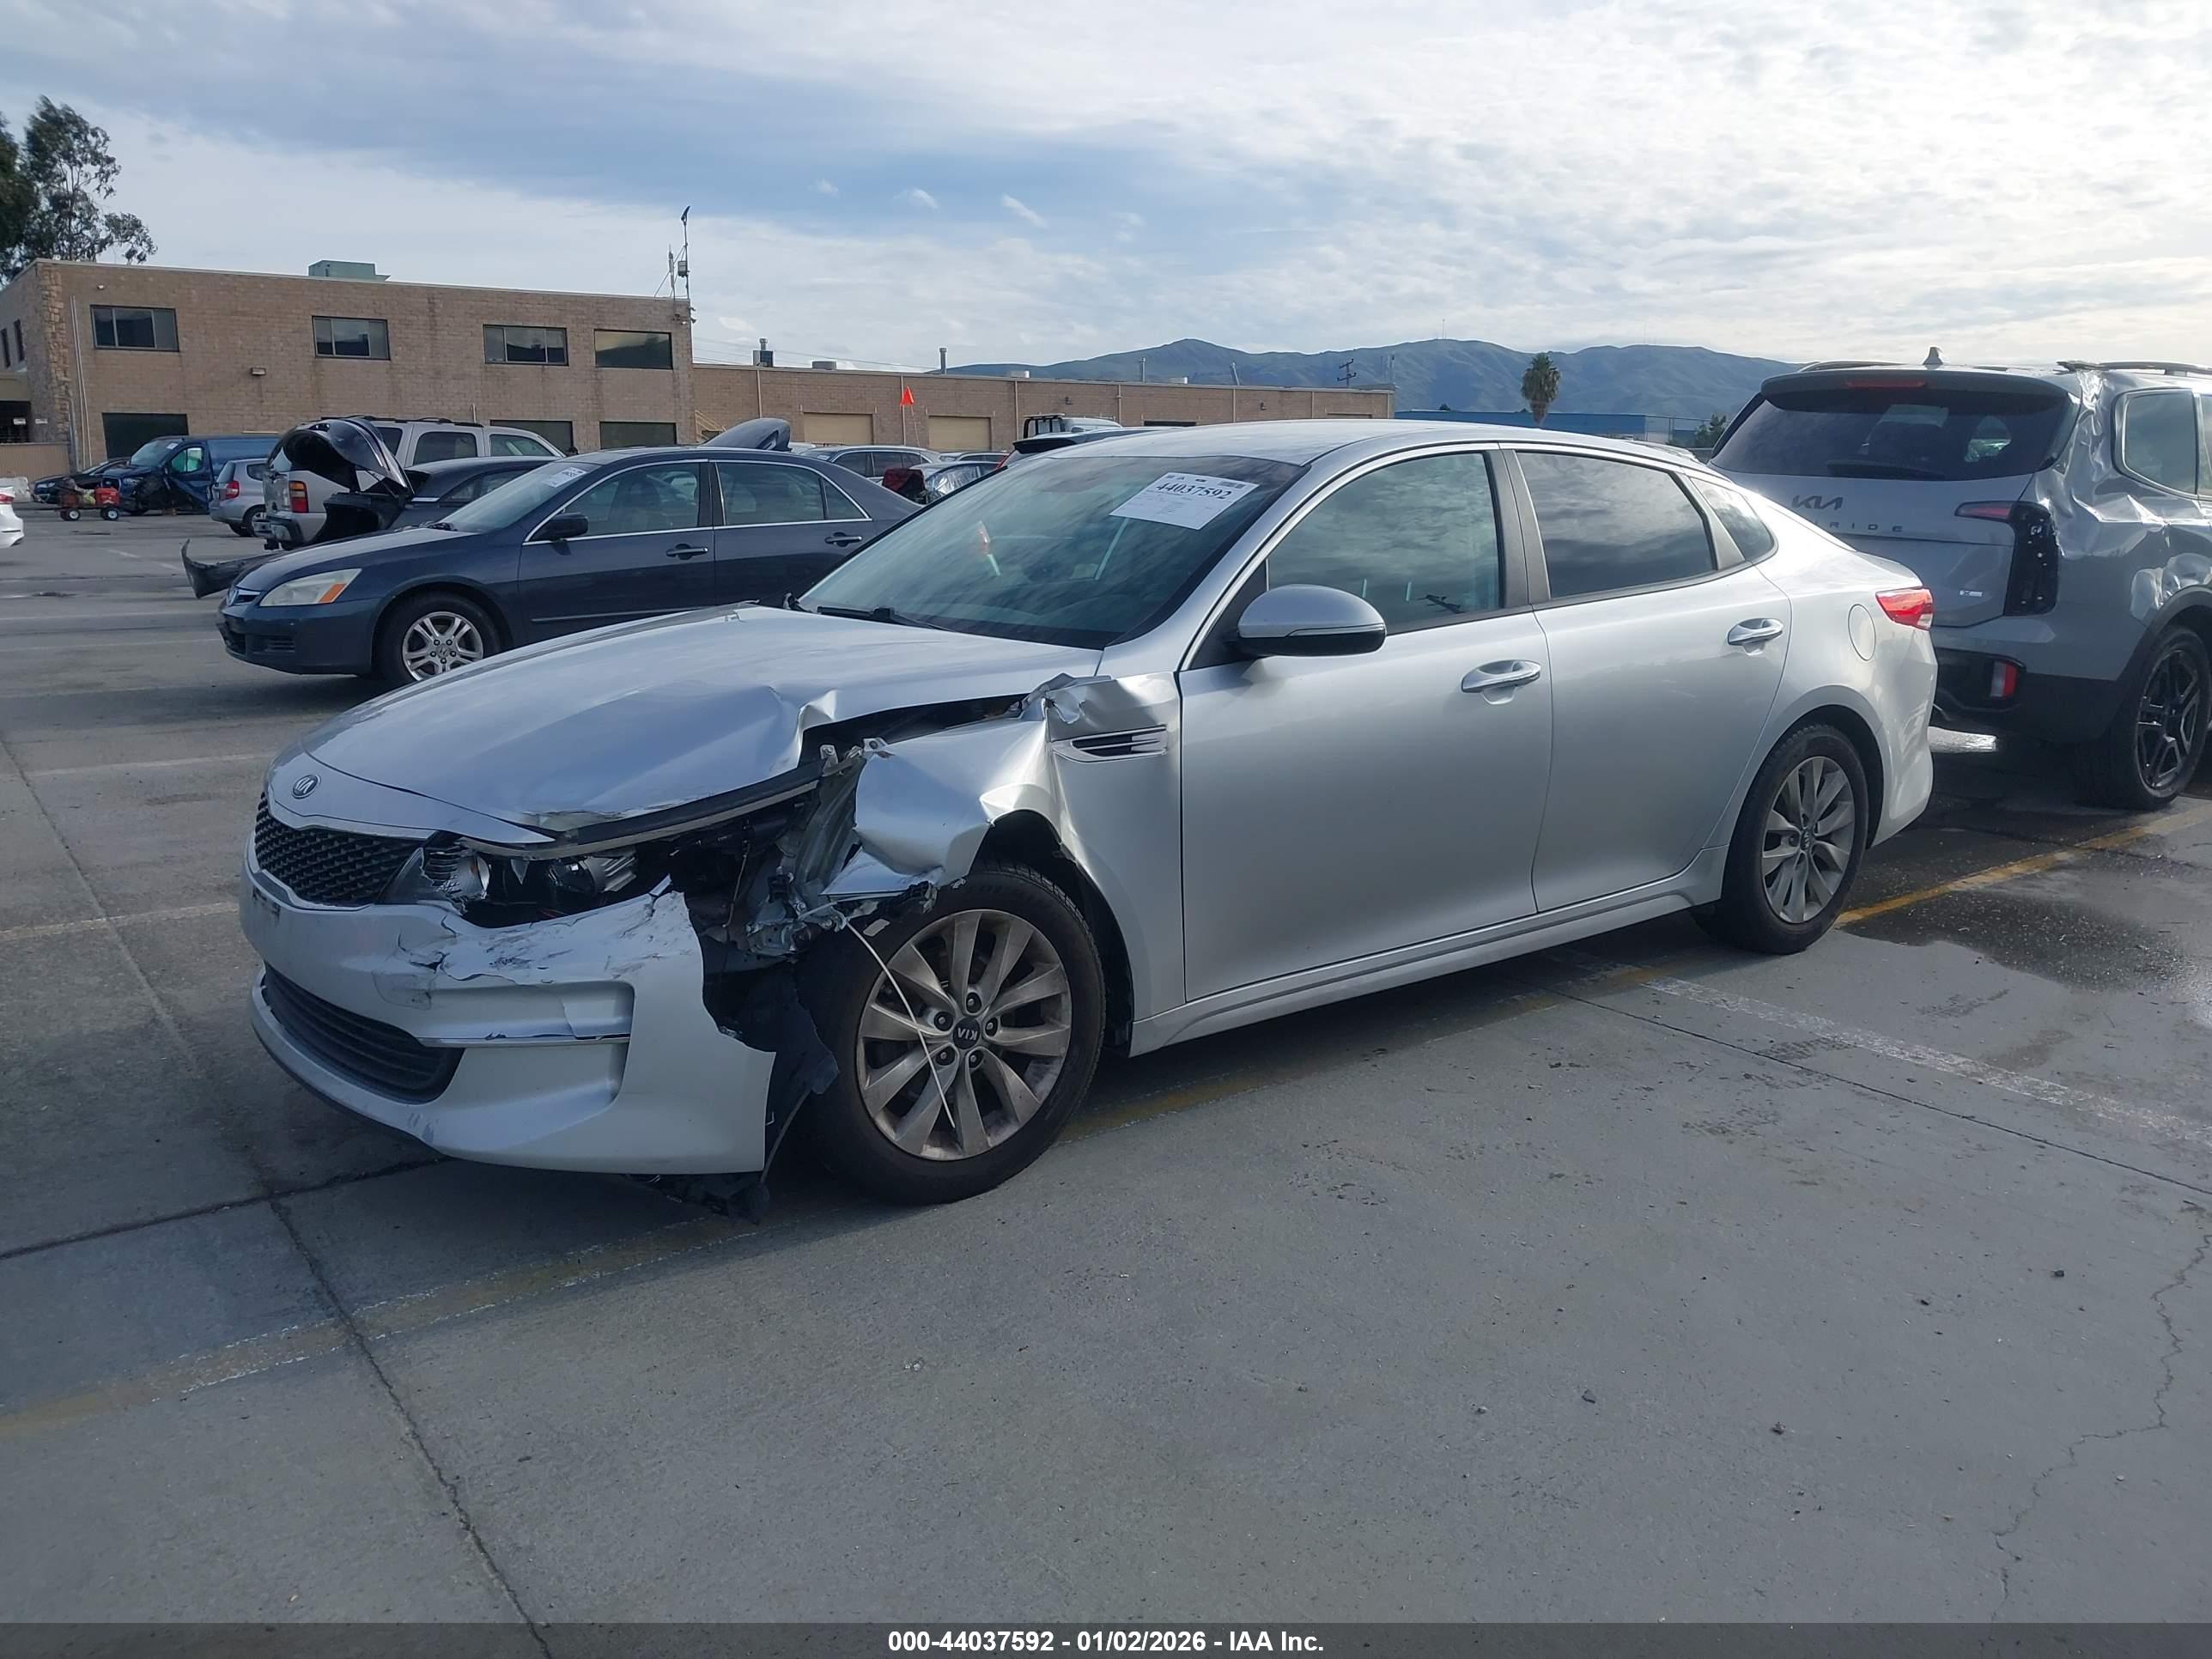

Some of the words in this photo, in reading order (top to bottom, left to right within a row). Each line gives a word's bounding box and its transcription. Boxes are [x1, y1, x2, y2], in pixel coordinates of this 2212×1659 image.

[1156, 482, 1232, 499] 44037592
[1791, 495, 1844, 511] KIA
[957, 1027, 979, 1041] KIA
